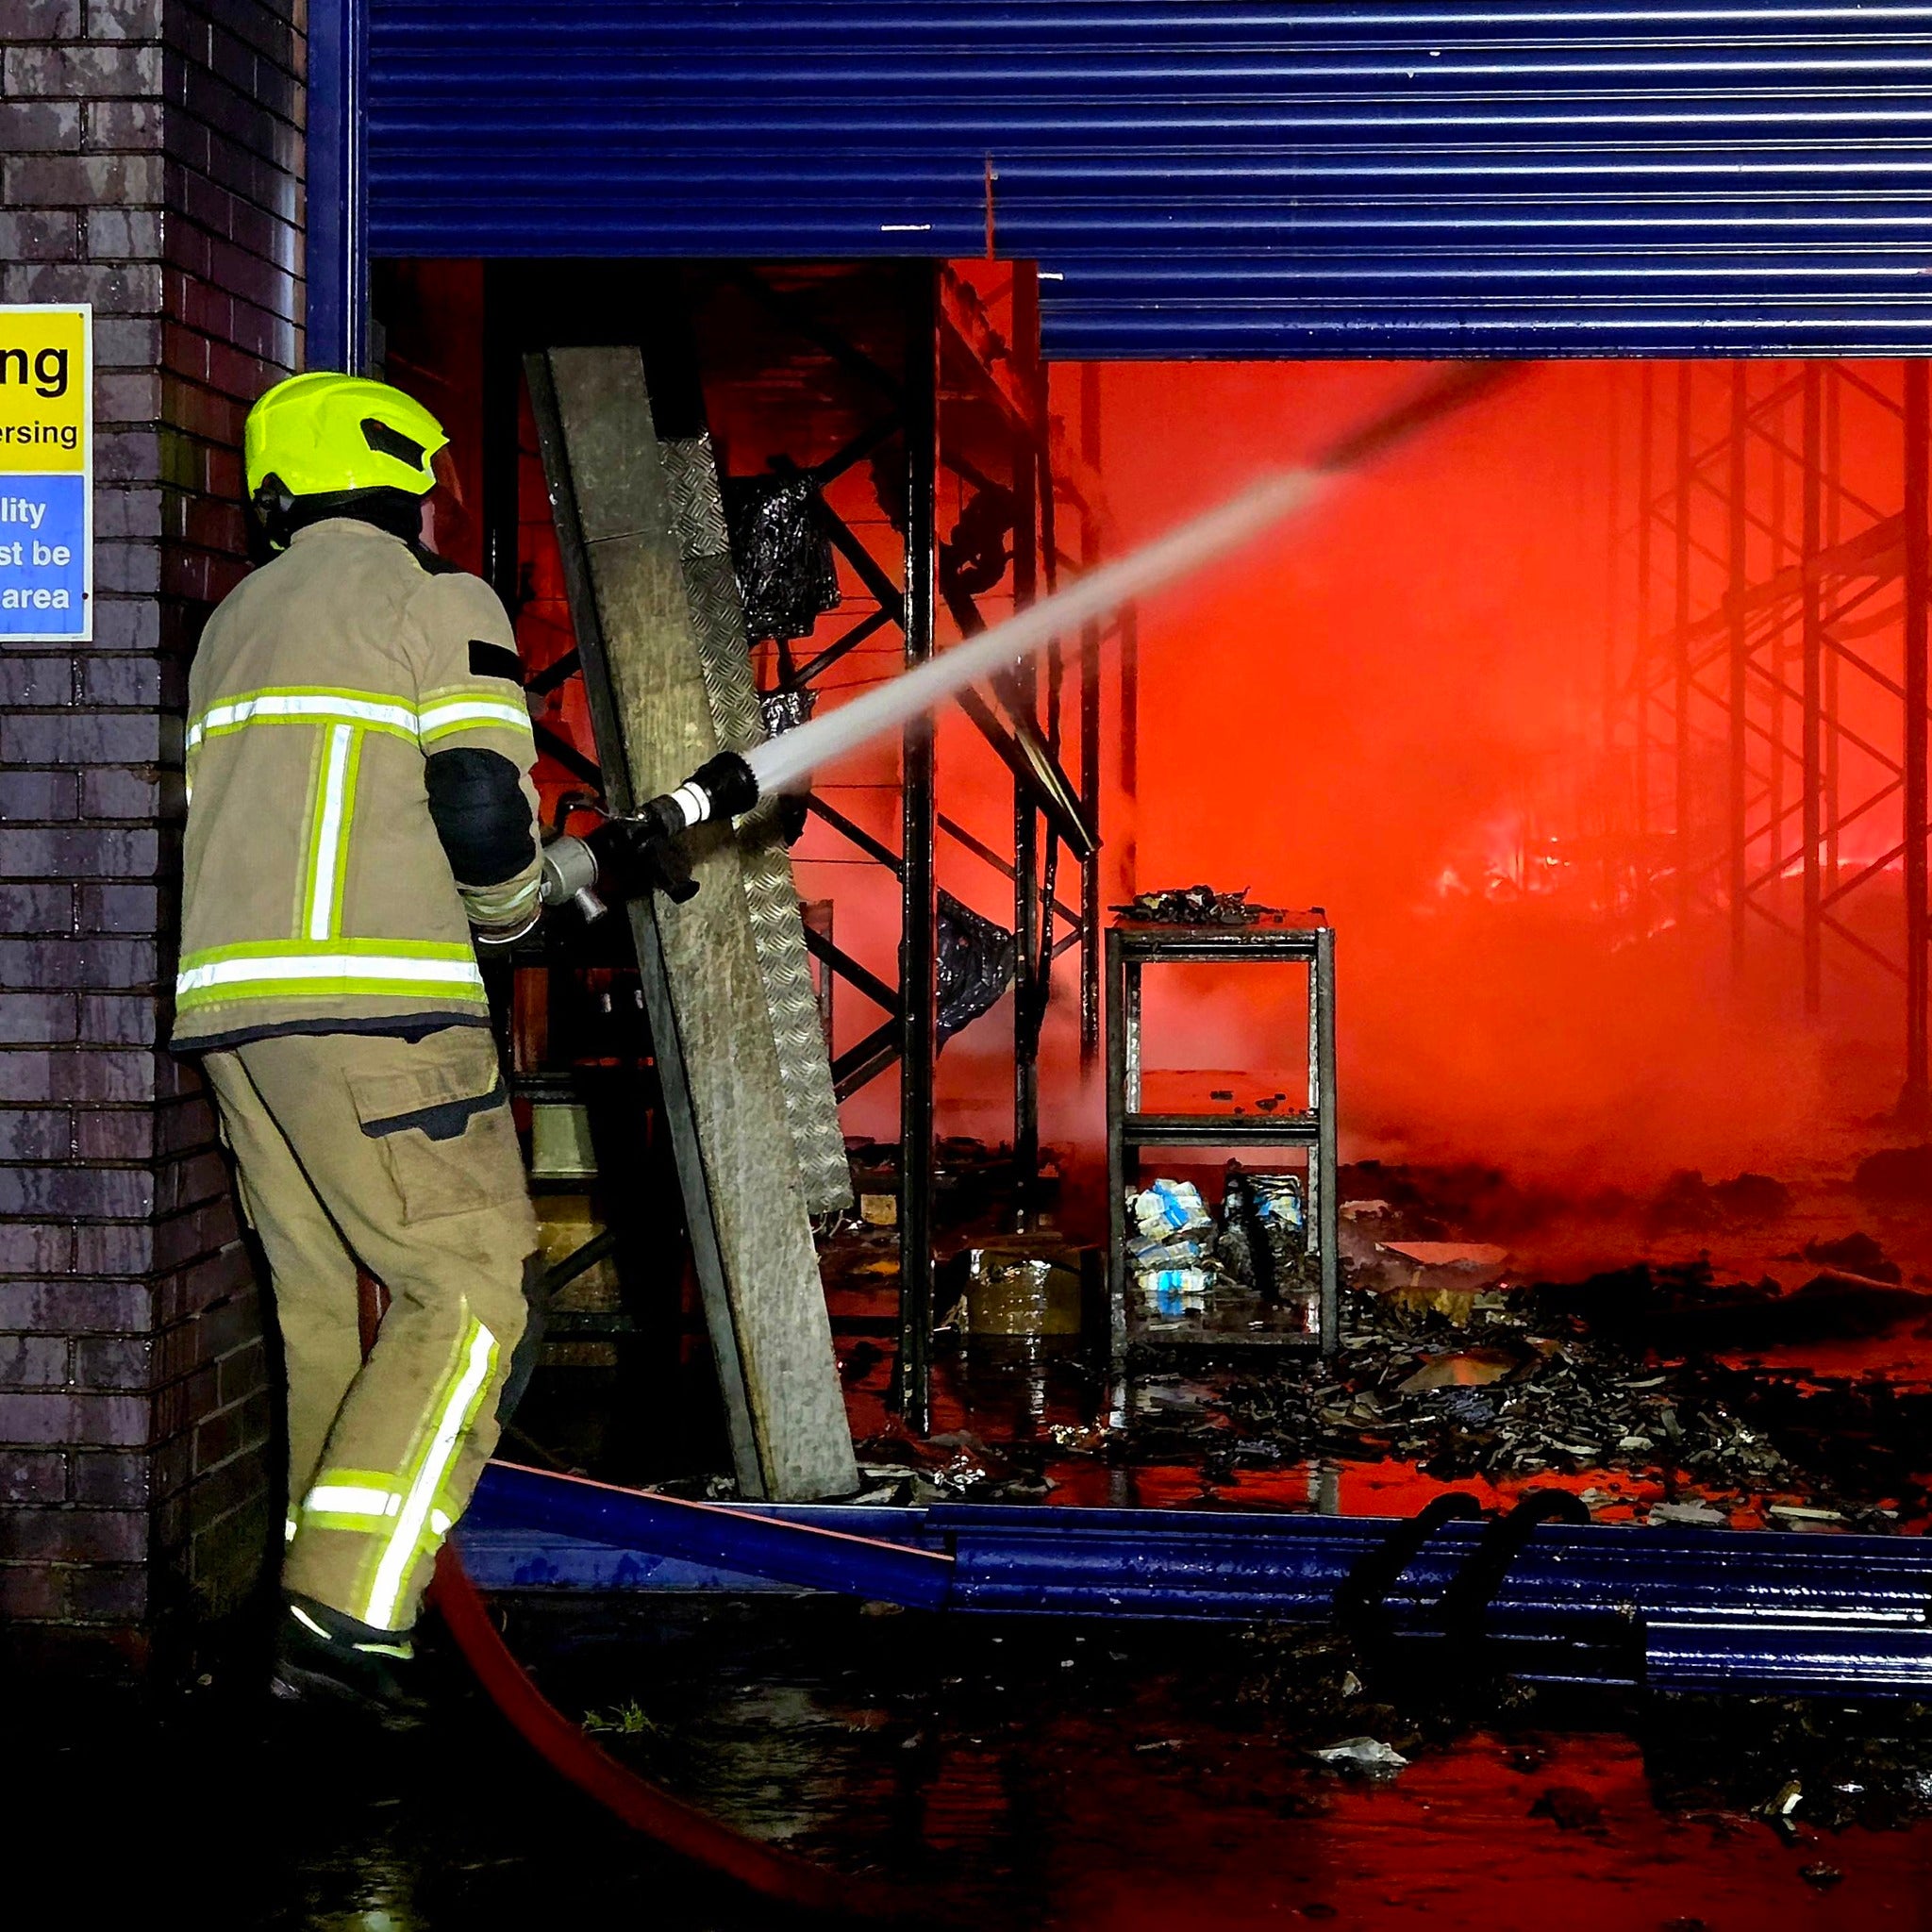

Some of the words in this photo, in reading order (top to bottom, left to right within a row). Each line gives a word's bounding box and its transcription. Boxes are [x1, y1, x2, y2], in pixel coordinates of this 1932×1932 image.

[0, 347, 68, 399] ng
[0, 420, 77, 450] rsing
[1, 496, 47, 530] lity
[0, 541, 24, 567] st
[32, 540, 72, 567] be
[1, 588, 71, 609] area
